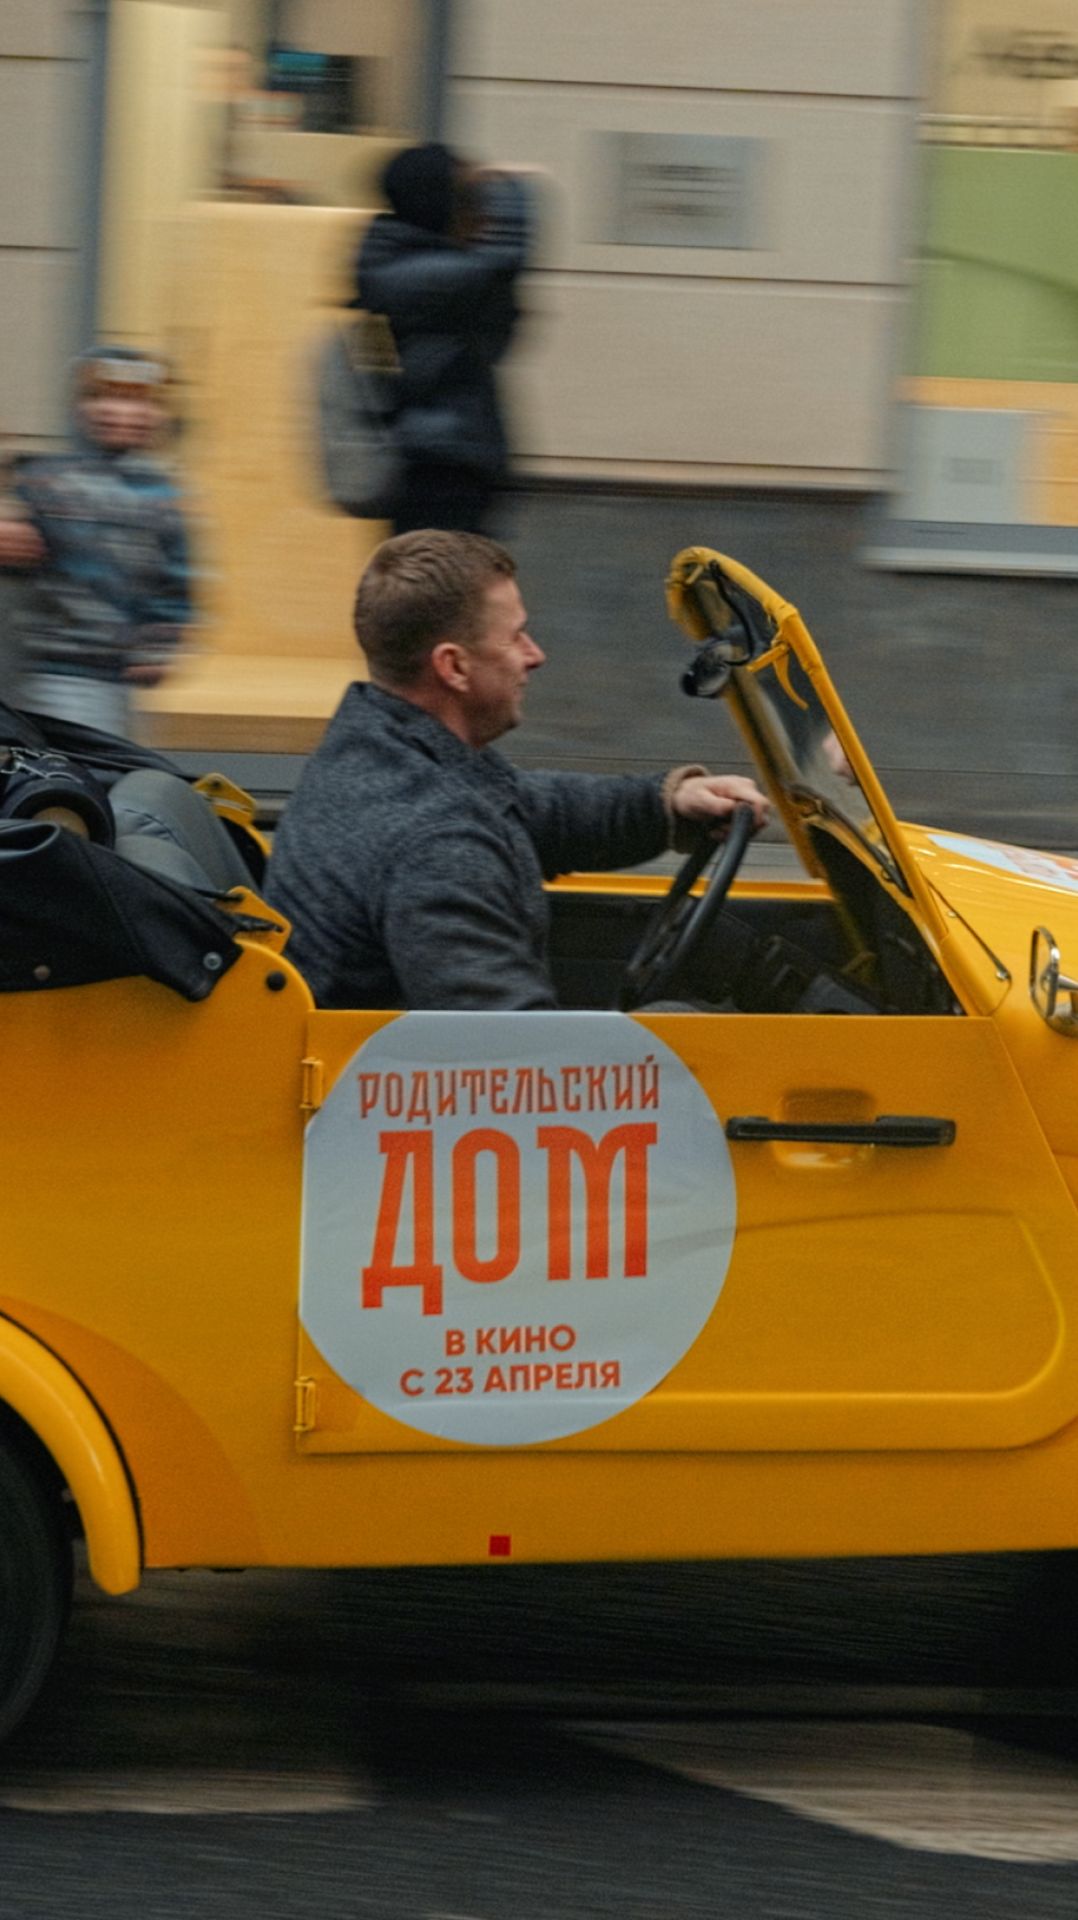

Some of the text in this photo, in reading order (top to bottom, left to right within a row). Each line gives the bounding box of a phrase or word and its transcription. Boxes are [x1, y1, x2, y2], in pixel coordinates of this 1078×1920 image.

[358, 1055, 660, 1124] РОДИТЕЛЬСКИЙ
[361, 1122, 658, 1317] ДОМ
[444, 1324, 577, 1357] В КИНО
[400, 1360, 621, 1397] С 23 АПРЕЛЯ
